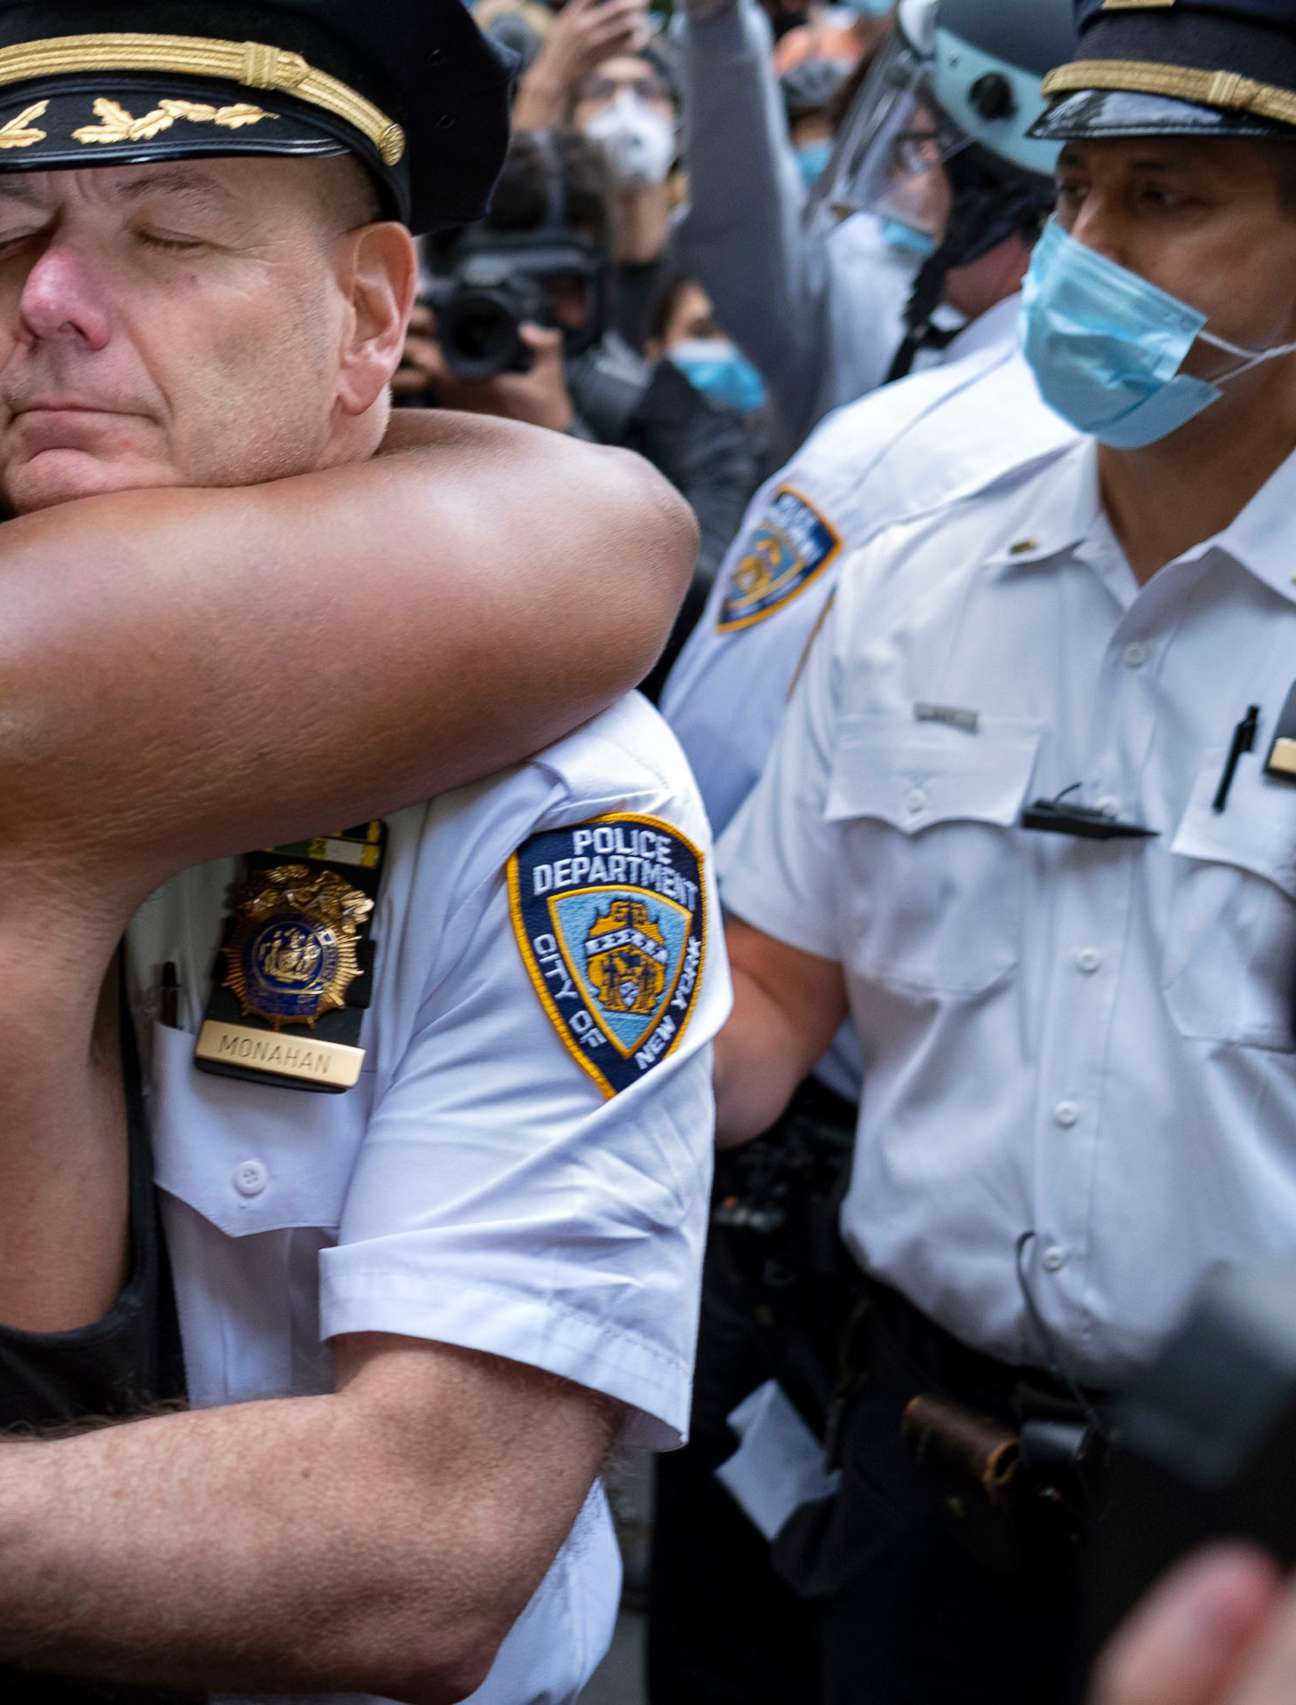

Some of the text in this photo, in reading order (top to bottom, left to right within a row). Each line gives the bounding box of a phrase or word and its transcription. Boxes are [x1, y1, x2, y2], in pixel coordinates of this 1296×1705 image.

[573, 827, 673, 865] POLICE
[533, 855, 699, 911] DEPARTMENT
[533, 933, 608, 1049] CITY OF
[633, 935, 701, 1070] NEW YORK
[218, 1034, 333, 1075] MONAHAN
